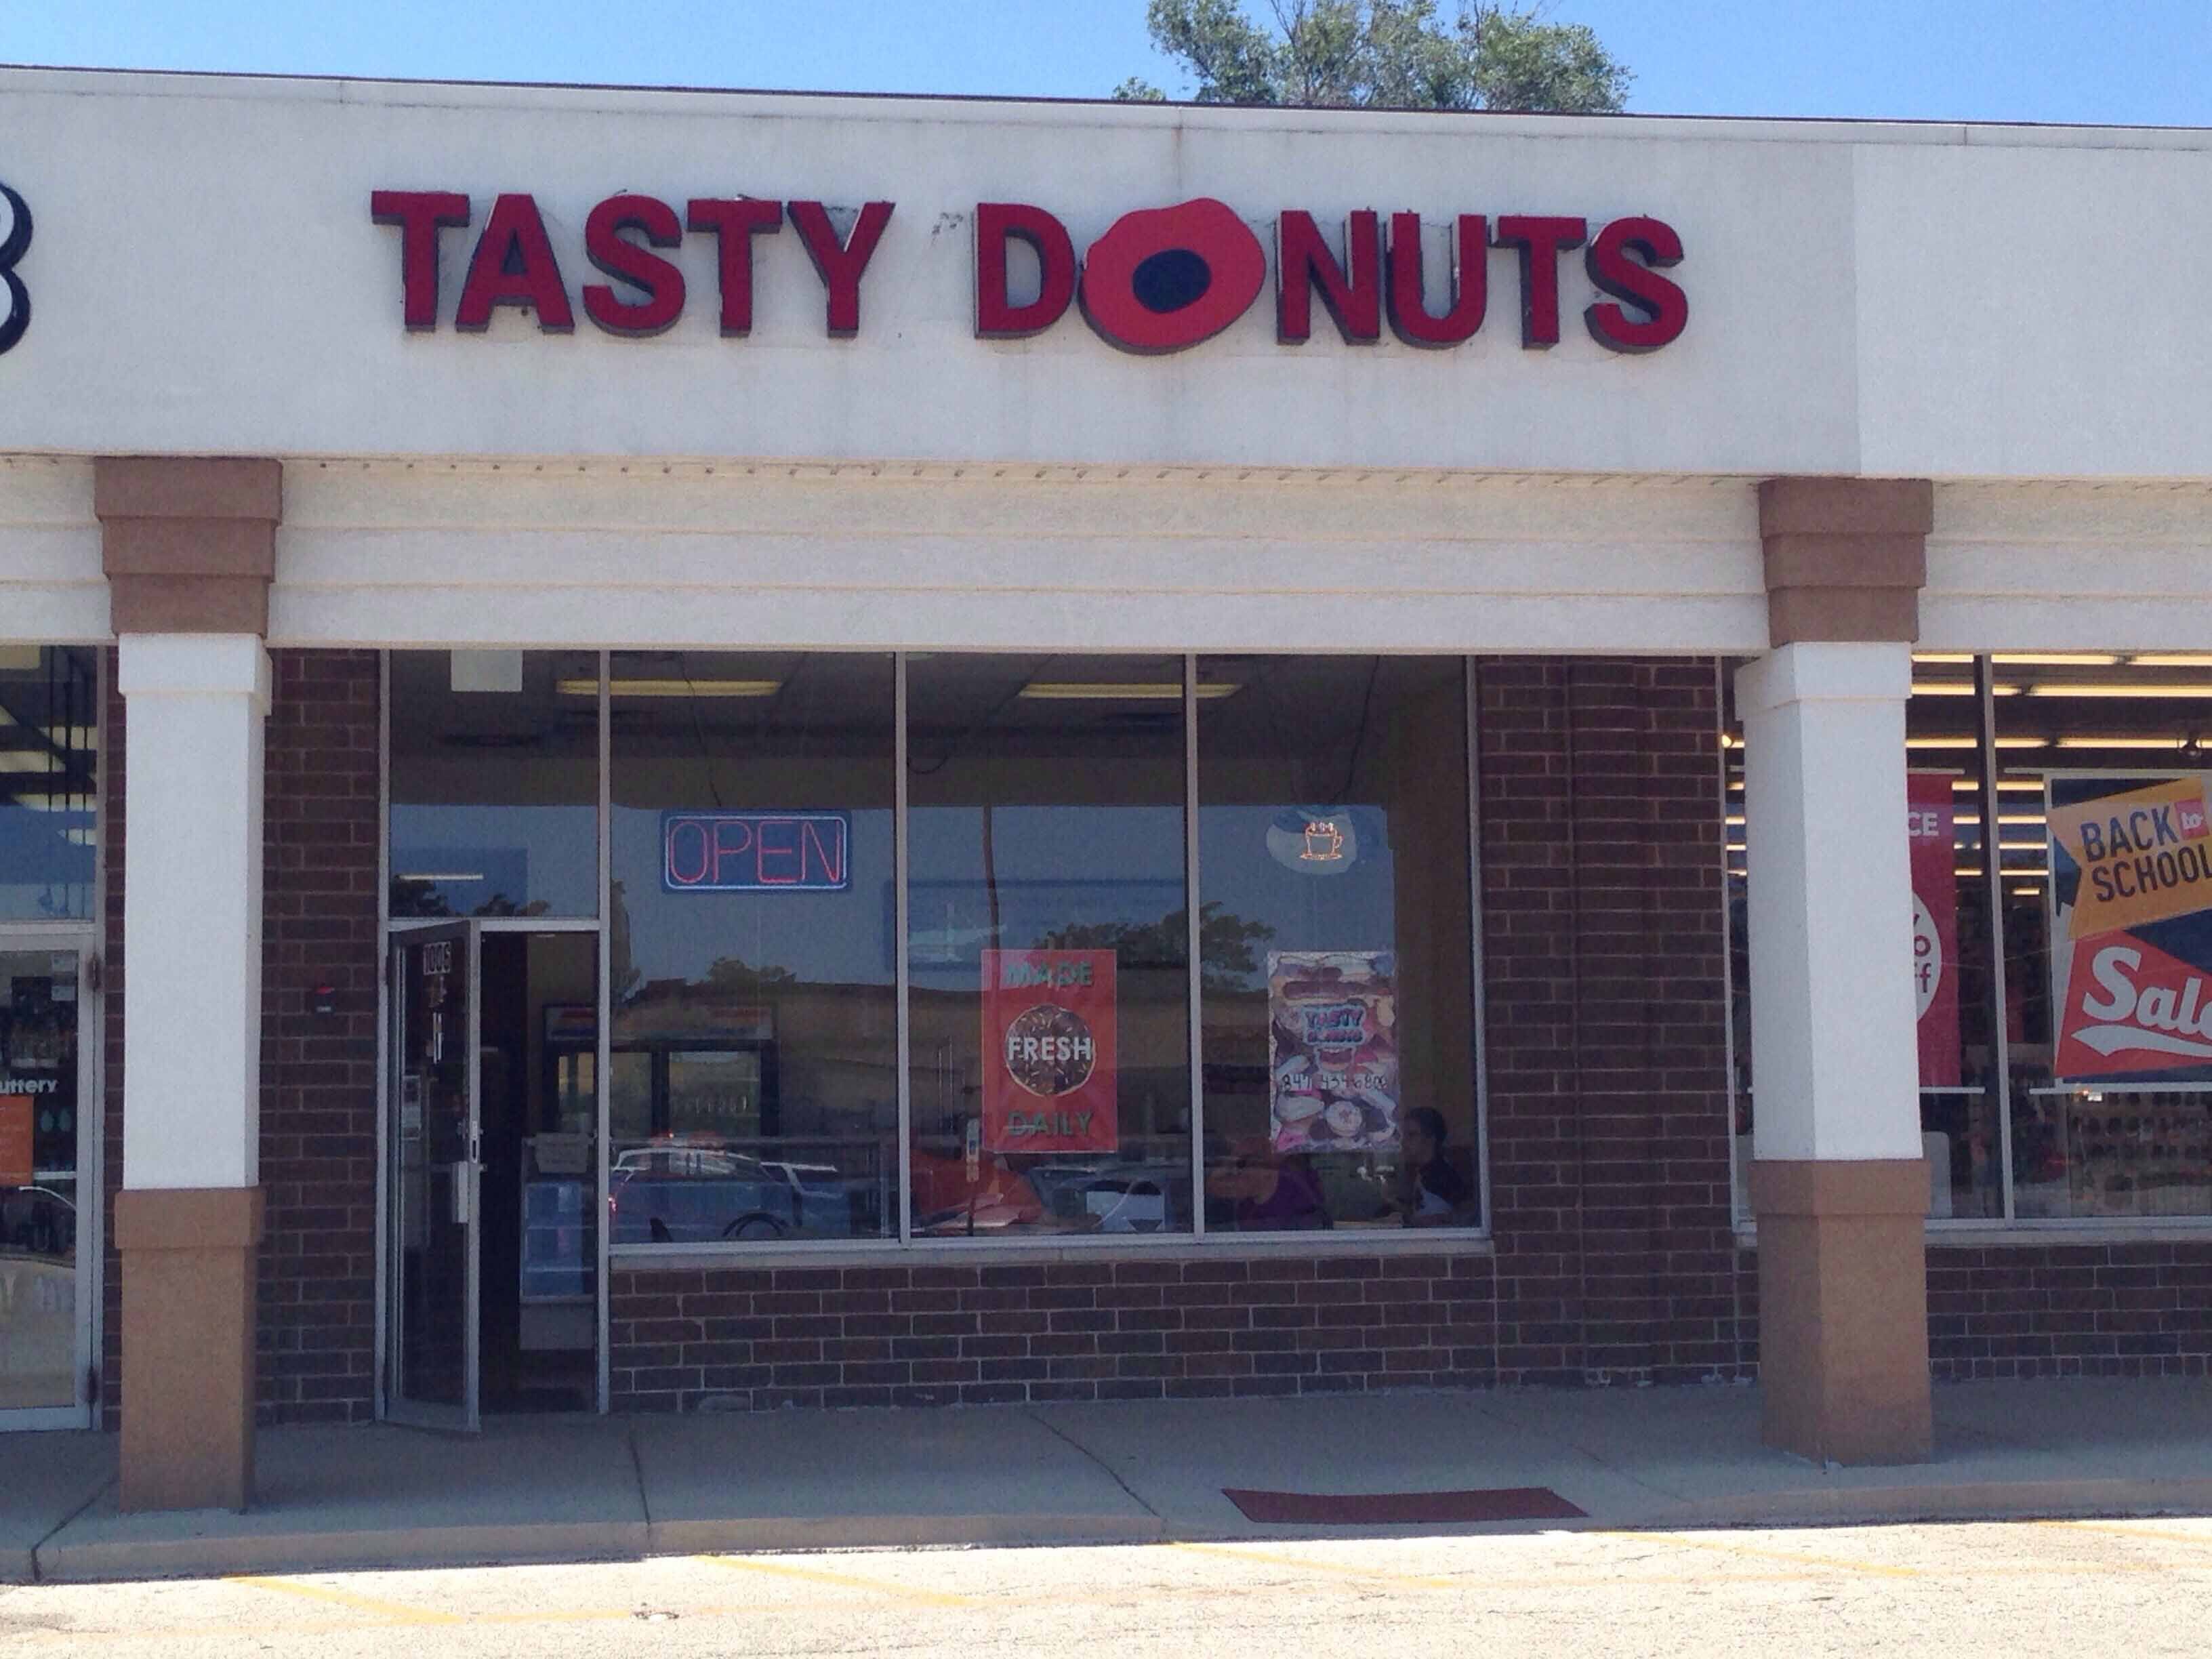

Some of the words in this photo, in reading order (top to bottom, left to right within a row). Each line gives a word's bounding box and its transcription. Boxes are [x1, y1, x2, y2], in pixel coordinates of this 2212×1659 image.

[371, 190, 895, 338] TASTY
[973, 198, 1689, 355] DONUTS
[669, 820, 841, 884] OPEN
[2081, 805, 2178, 861] BACK
[2181, 812, 2203, 830] to
[2091, 844, 2212, 902] SCHOOL
[1007, 960, 1093, 987] MADE
[1008, 1036, 1091, 1061] FRESH
[1008, 1111, 1092, 1136] DAILY
